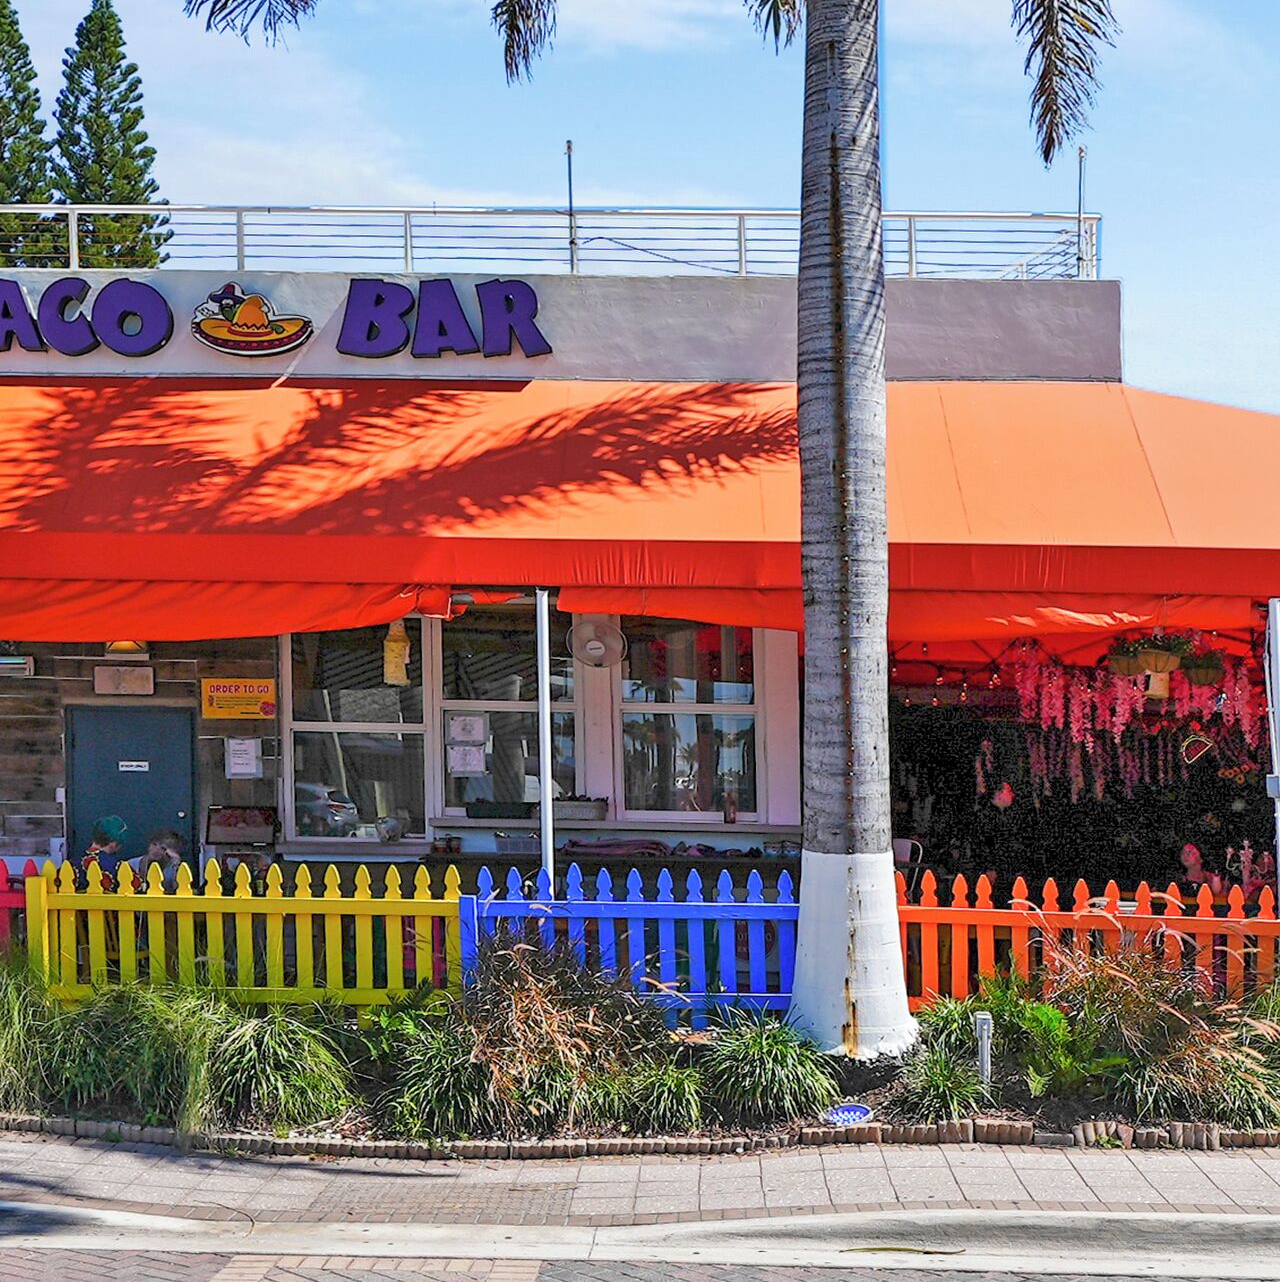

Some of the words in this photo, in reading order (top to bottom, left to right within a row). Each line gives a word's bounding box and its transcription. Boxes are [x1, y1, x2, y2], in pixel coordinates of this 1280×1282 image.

[337, 278, 552, 359] BAR
[209, 684, 240, 694] ORDER
[243, 684, 255, 694] TO
[257, 685, 269, 694] GO
